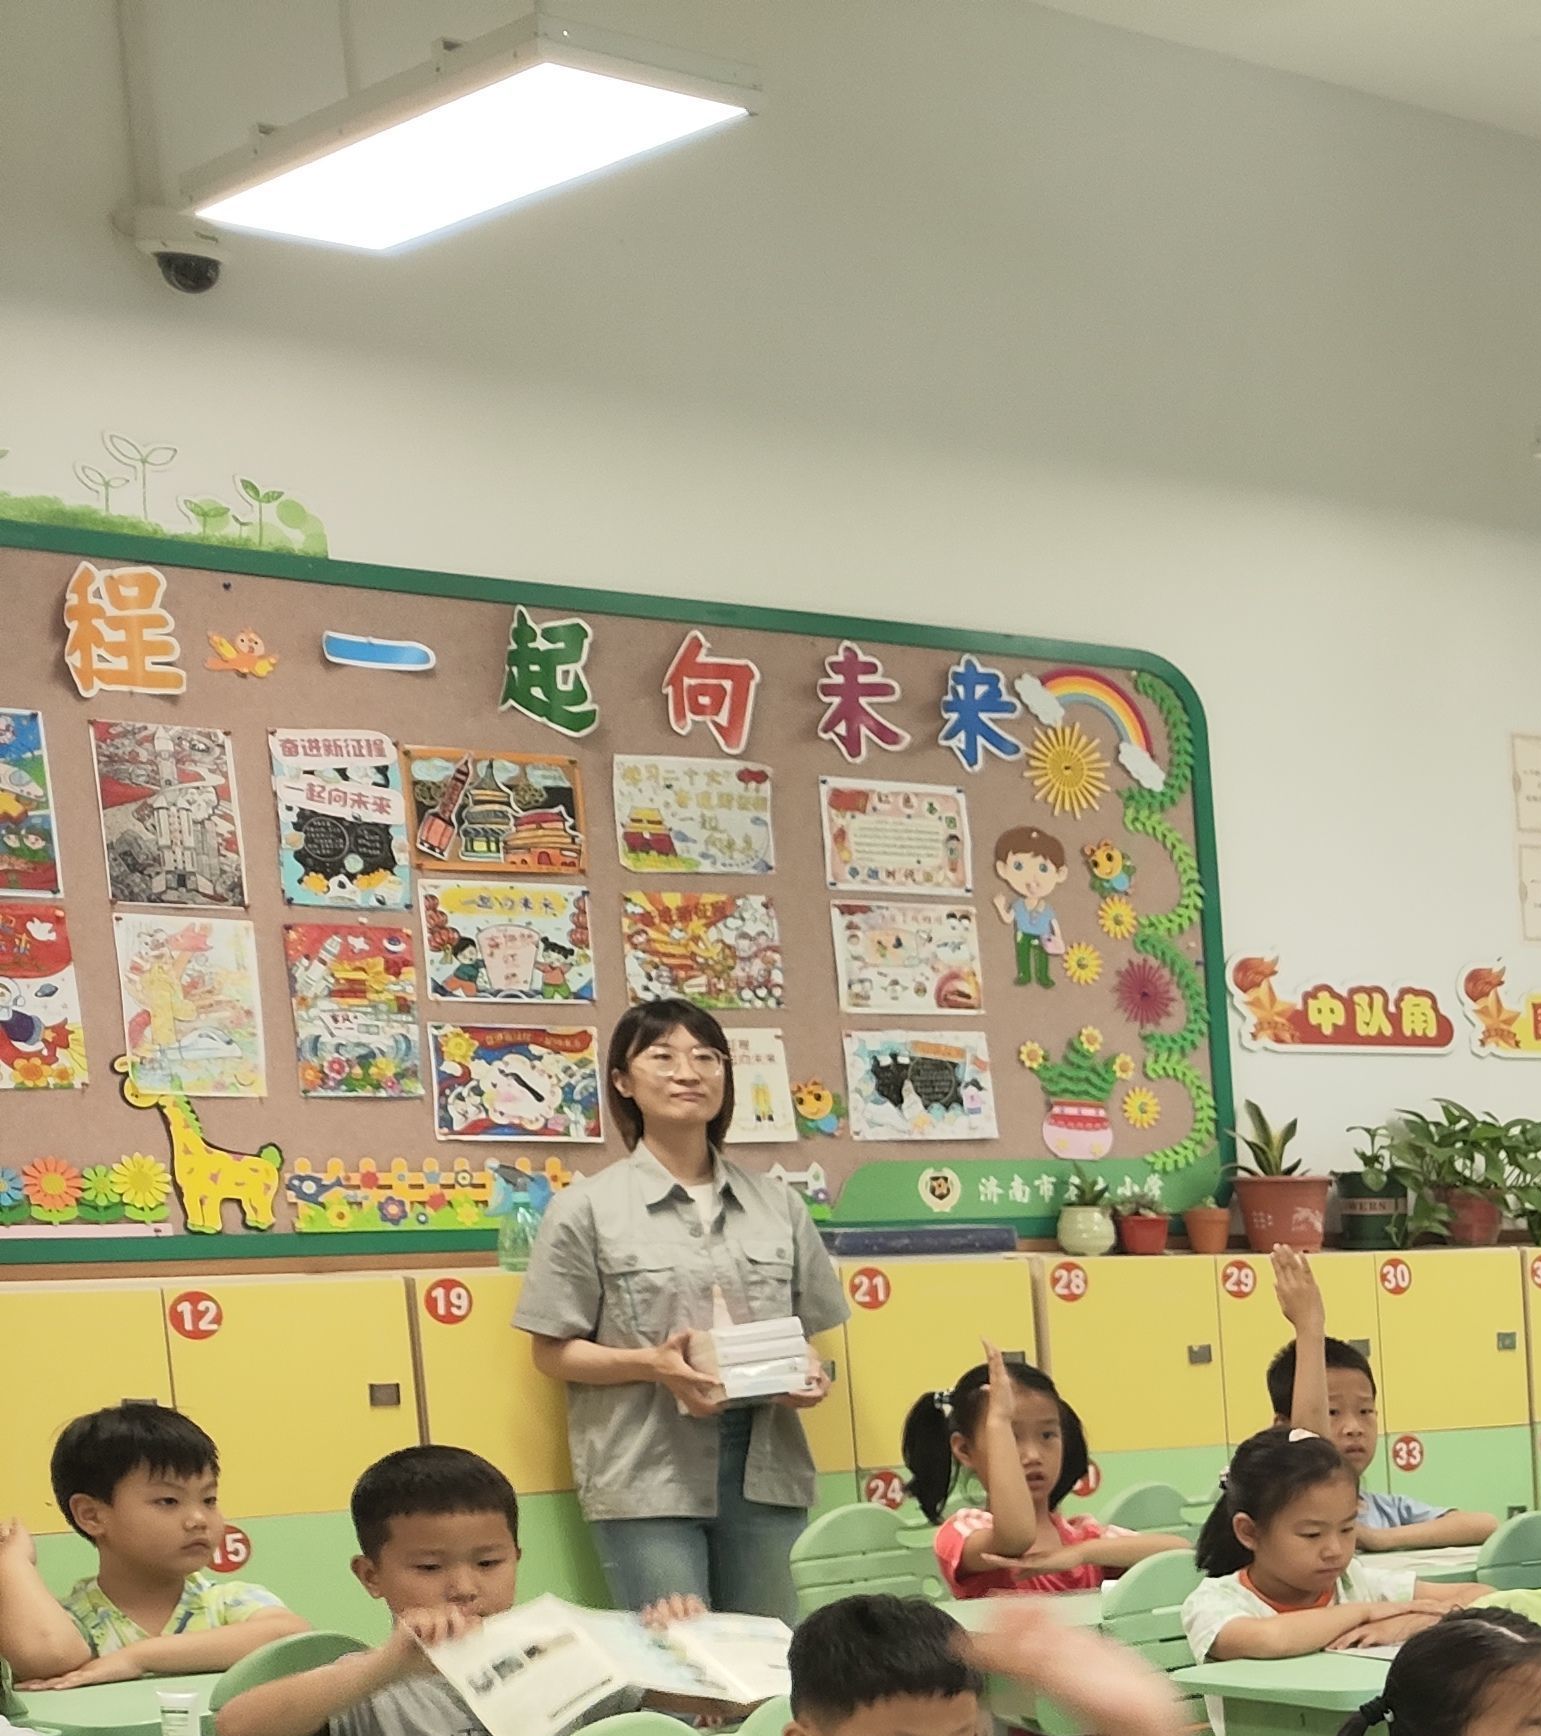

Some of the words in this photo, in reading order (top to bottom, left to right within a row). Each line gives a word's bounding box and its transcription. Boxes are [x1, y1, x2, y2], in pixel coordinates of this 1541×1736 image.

[64, 561, 187, 698] 程
[321, 603, 1022, 773] 一起向未来
[1306, 991, 1440, 1037] 中队角
[853, 1274, 886, 1302] 21
[1053, 1268, 1087, 1296] 28
[1224, 1267, 1254, 1293] 29
[1382, 1264, 1411, 1290] 30
[176, 1300, 219, 1331] 12
[431, 1286, 470, 1317] 19
[1395, 1441, 1421, 1467] 33
[869, 1478, 902, 1505] 24
[1073, 1464, 1096, 1491] 1
